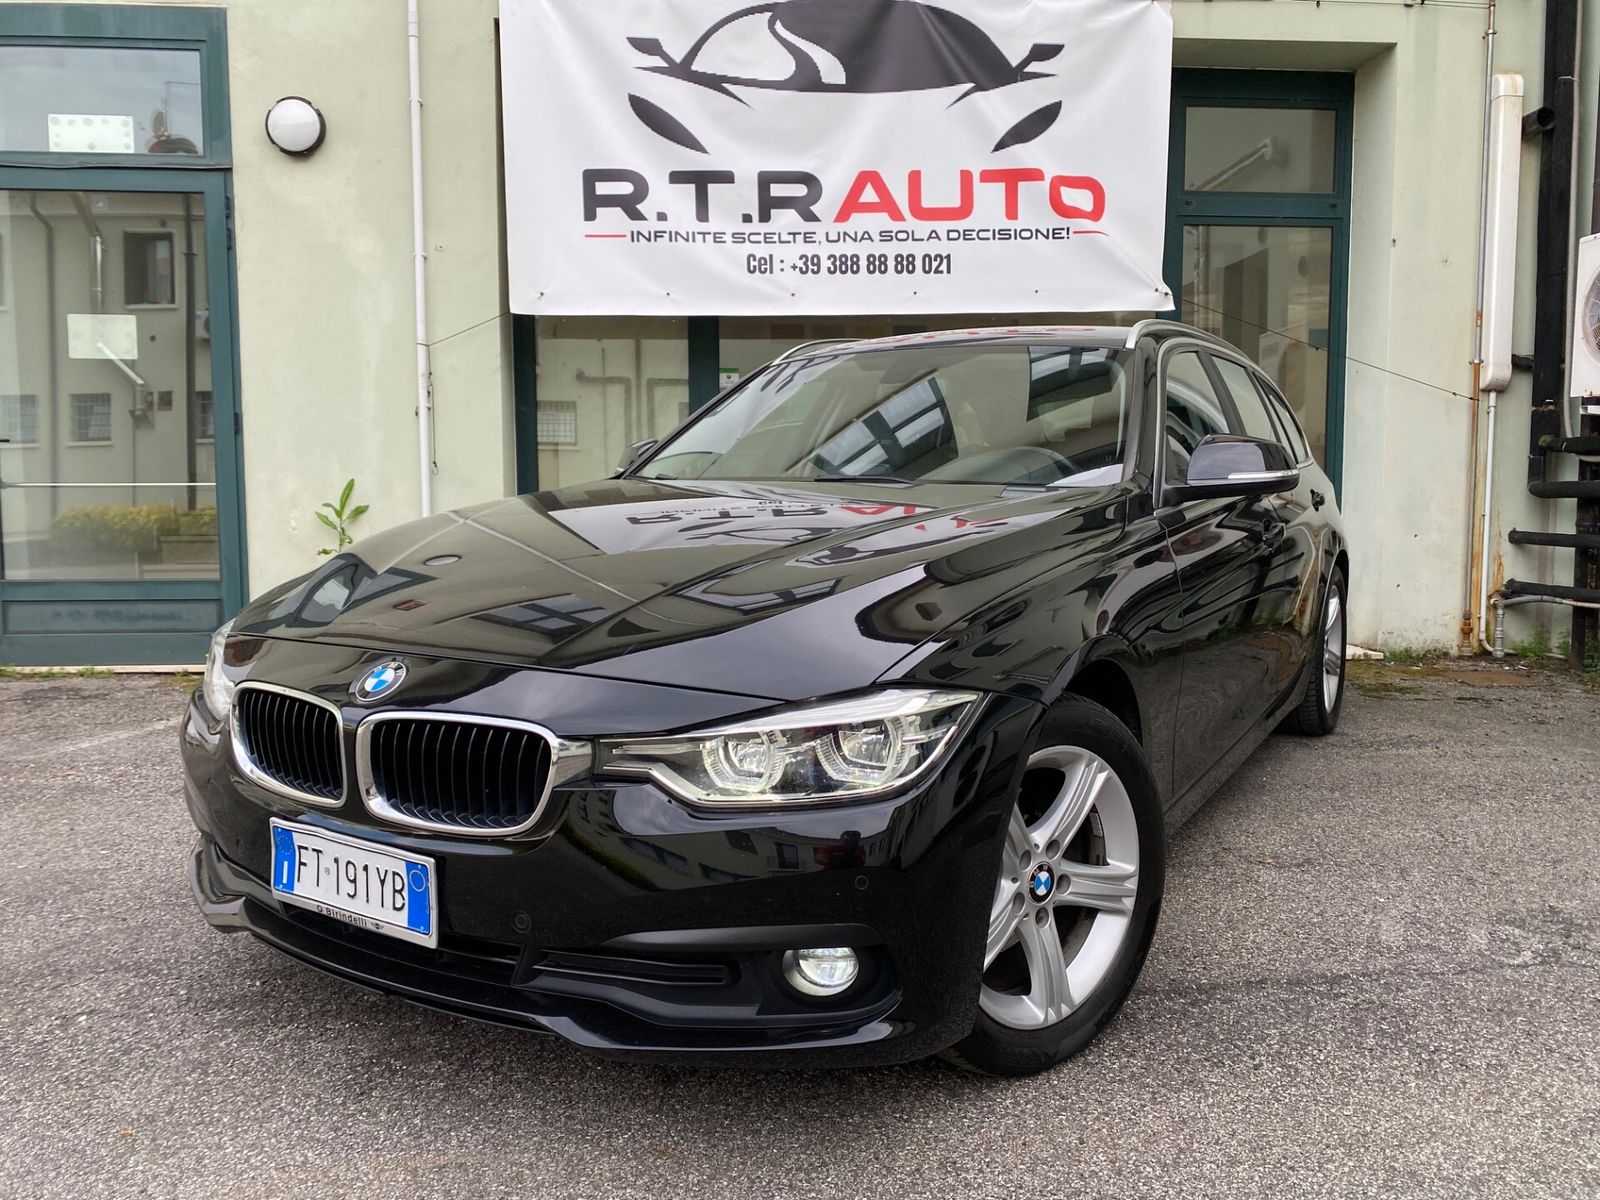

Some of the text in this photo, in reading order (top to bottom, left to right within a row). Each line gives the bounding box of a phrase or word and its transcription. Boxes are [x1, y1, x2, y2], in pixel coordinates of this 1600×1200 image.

[630, 227, 1070, 246] INFINITE SCELTE, UNA SOLA DECISIONE!
[746, 253, 774, 274] Cel
[790, 253, 821, 274] +39
[827, 253, 860, 274] 388
[866, 253, 888, 274] 88
[894, 253, 916, 274] 88
[922, 253, 951, 274] 021
[325, 906, 368, 928] Birindelli
